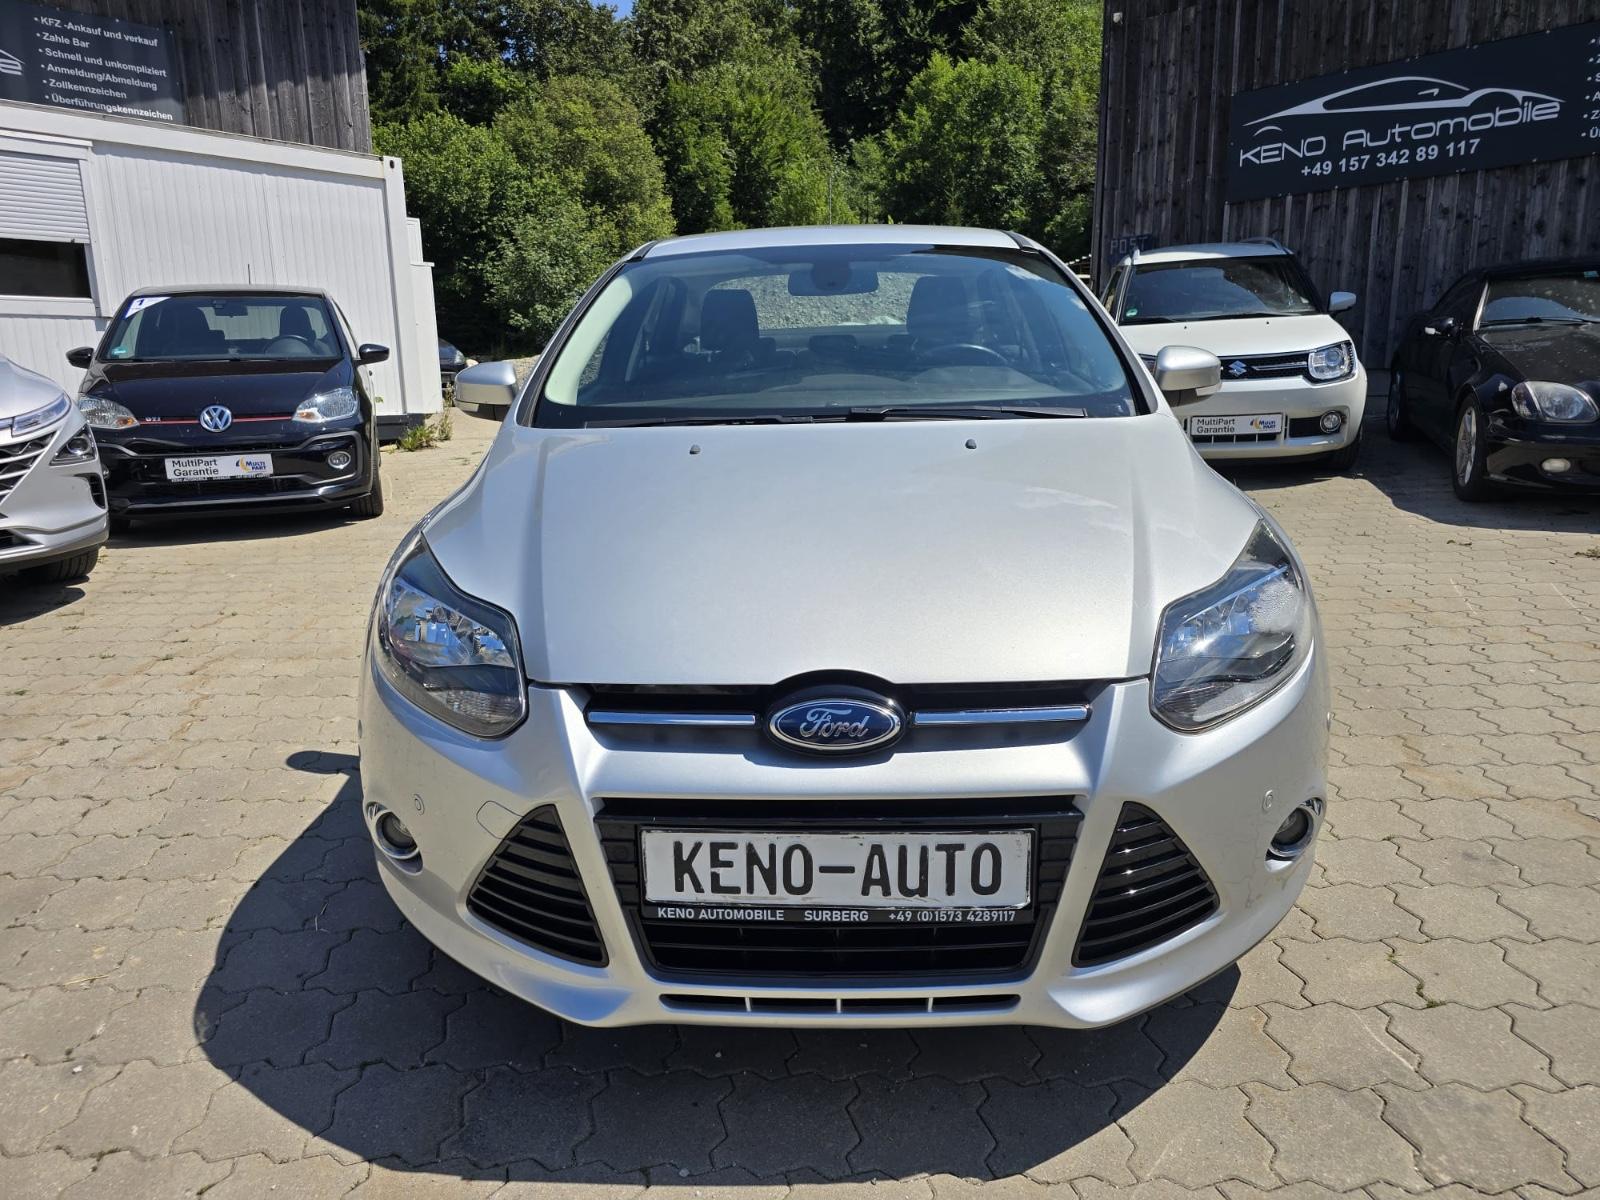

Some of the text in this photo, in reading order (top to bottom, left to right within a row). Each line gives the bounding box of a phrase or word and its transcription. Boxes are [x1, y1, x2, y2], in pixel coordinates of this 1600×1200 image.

[42, 32, 90, 49] Zahle Bar
[104, 29, 122, 40] und
[124, 34, 159, 48] verkauf
[44, 47, 167, 78] Schnell und unkompliziert
[49, 78, 127, 99] Zollkennzeichen
[51, 93, 173, 121] Überführungskennzeichen
[1239, 101, 1561, 167] KENO Automobile
[1301, 138, 1481, 176] +49 157 342 89 117
[1110, 236, 1149, 255] POST
[1196, 418, 1236, 426] MultiPart
[1196, 426, 1236, 434] Garantie
[172, 459, 217, 468] MultiPart
[173, 468, 219, 477] Garantie
[799, 708, 871, 738] Ford
[672, 840, 1003, 898] KENO-AUTO
[657, 907, 1016, 923] KENO AUTOMOBILE SURBERG +49 (0)1573 4289117
